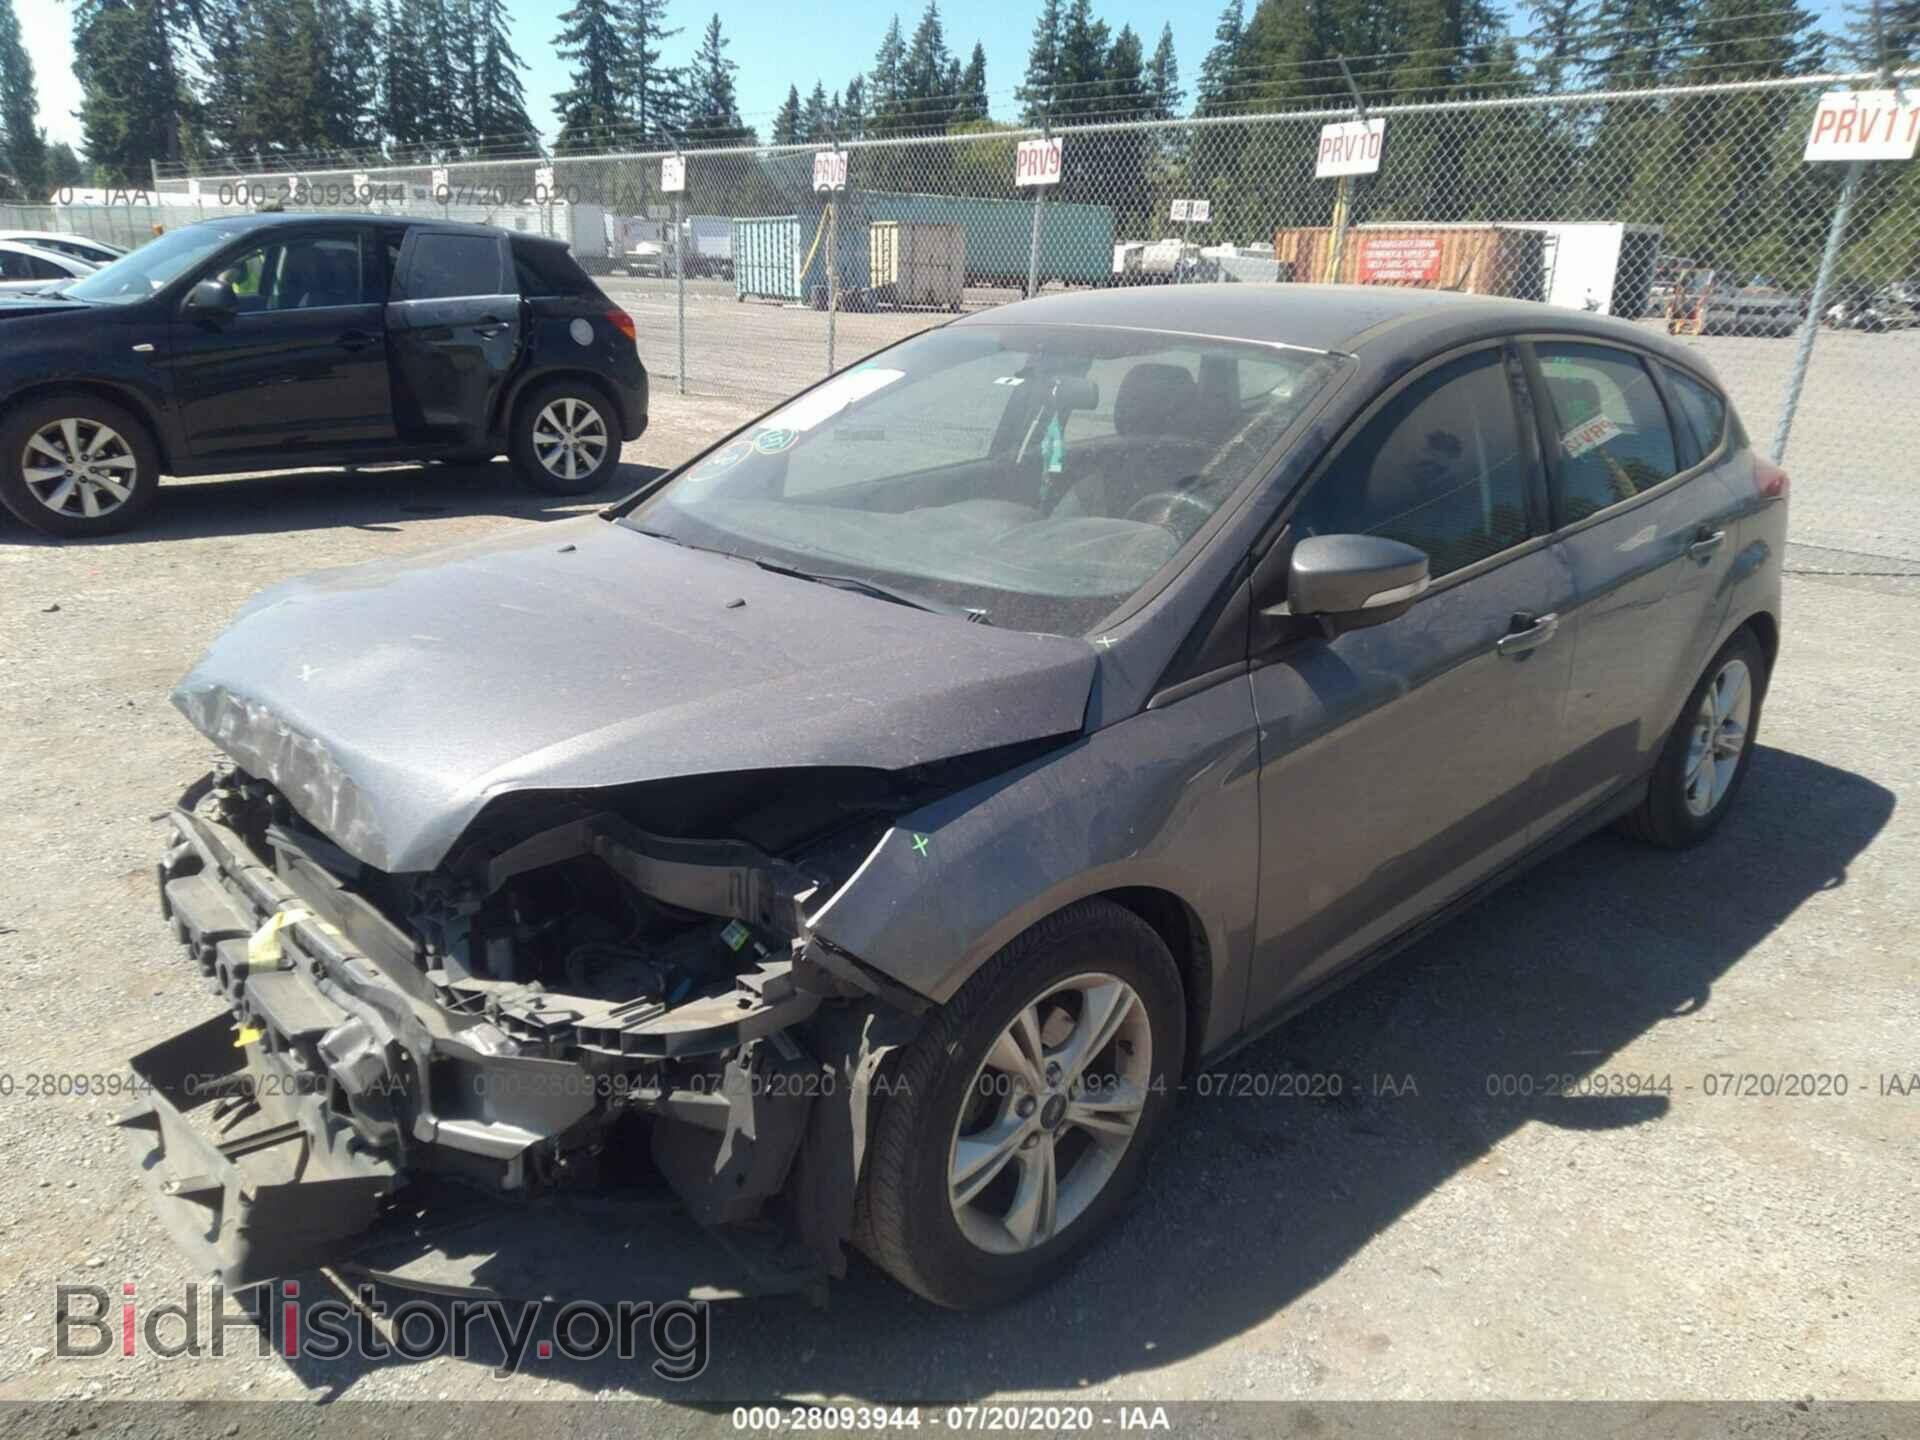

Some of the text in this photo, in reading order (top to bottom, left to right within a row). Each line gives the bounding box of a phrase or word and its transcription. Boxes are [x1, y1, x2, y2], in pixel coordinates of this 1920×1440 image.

[1813, 106, 1920, 144] PRV11
[1017, 147, 1060, 177] PRV9
[1319, 132, 1381, 164] PRV10
